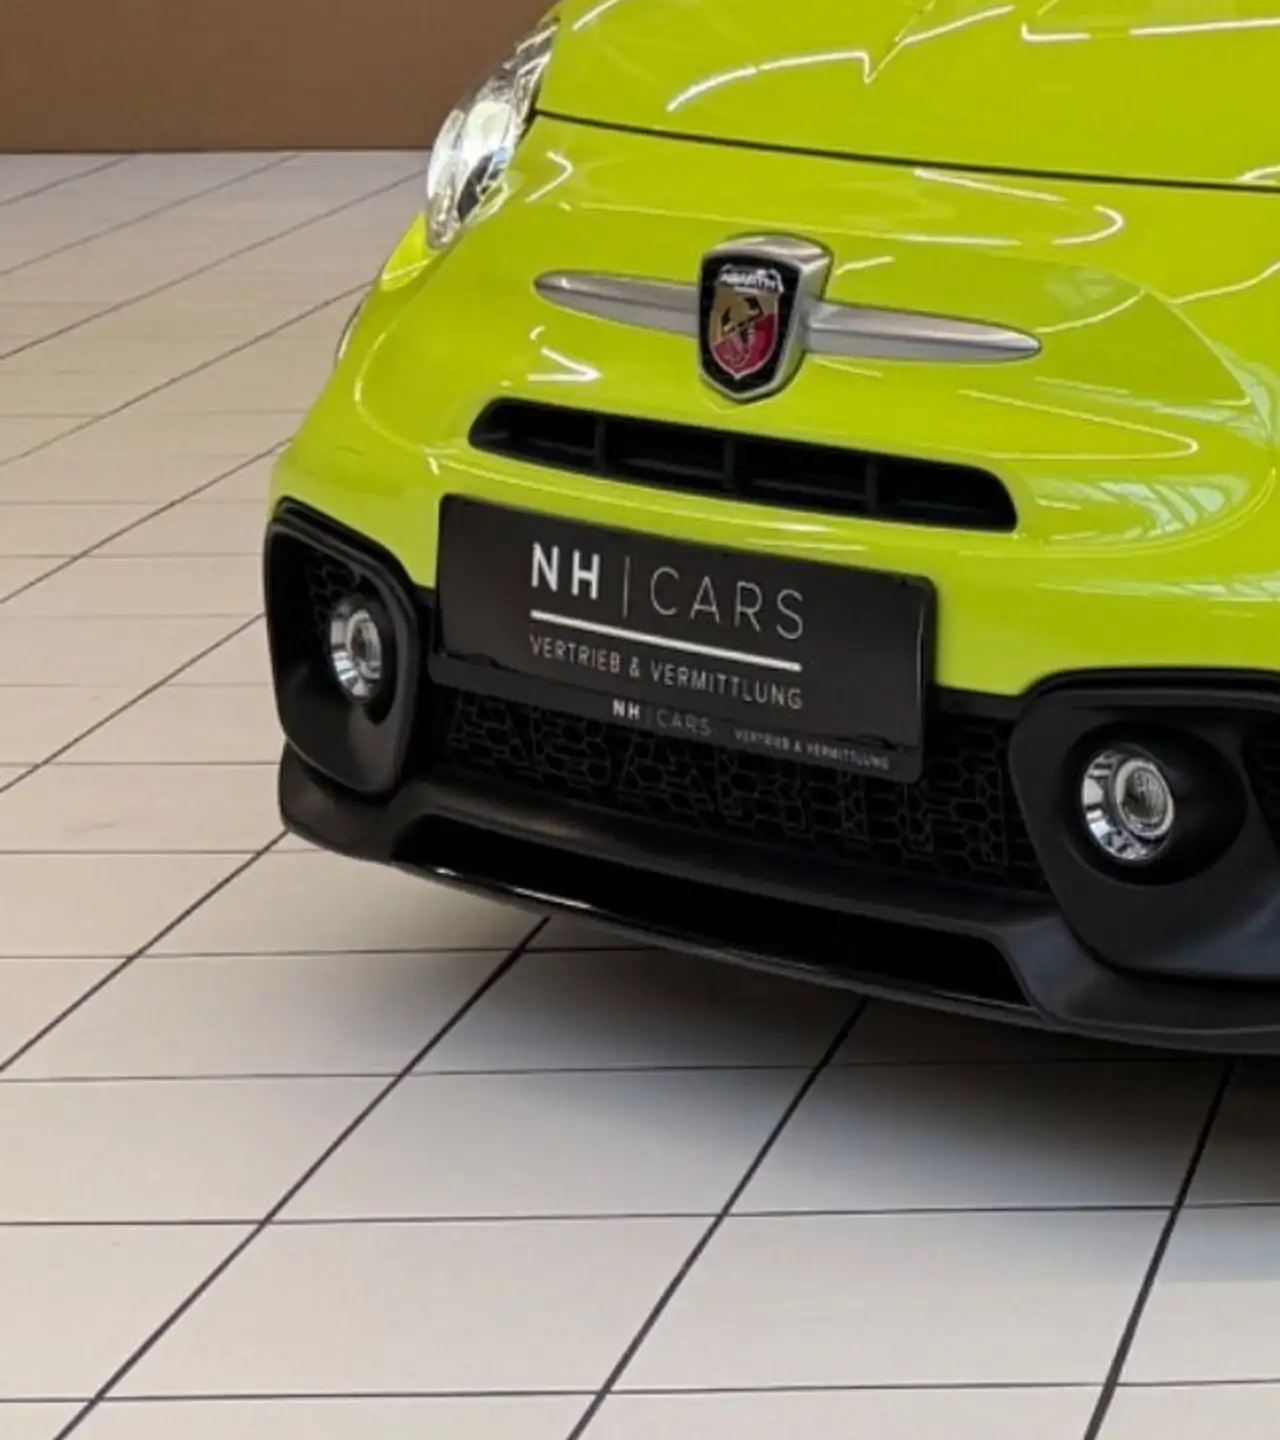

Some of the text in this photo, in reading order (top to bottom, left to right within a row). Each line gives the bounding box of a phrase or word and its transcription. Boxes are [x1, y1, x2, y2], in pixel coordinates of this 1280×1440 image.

[531, 541, 805, 641] NH CARS
[530, 634, 804, 710] VERTRIEB & VERMITTLUNG
[612, 698, 641, 721] NH
[656, 709, 712, 737] CARS
[807, 742, 890, 771] VERMITTLUNG
